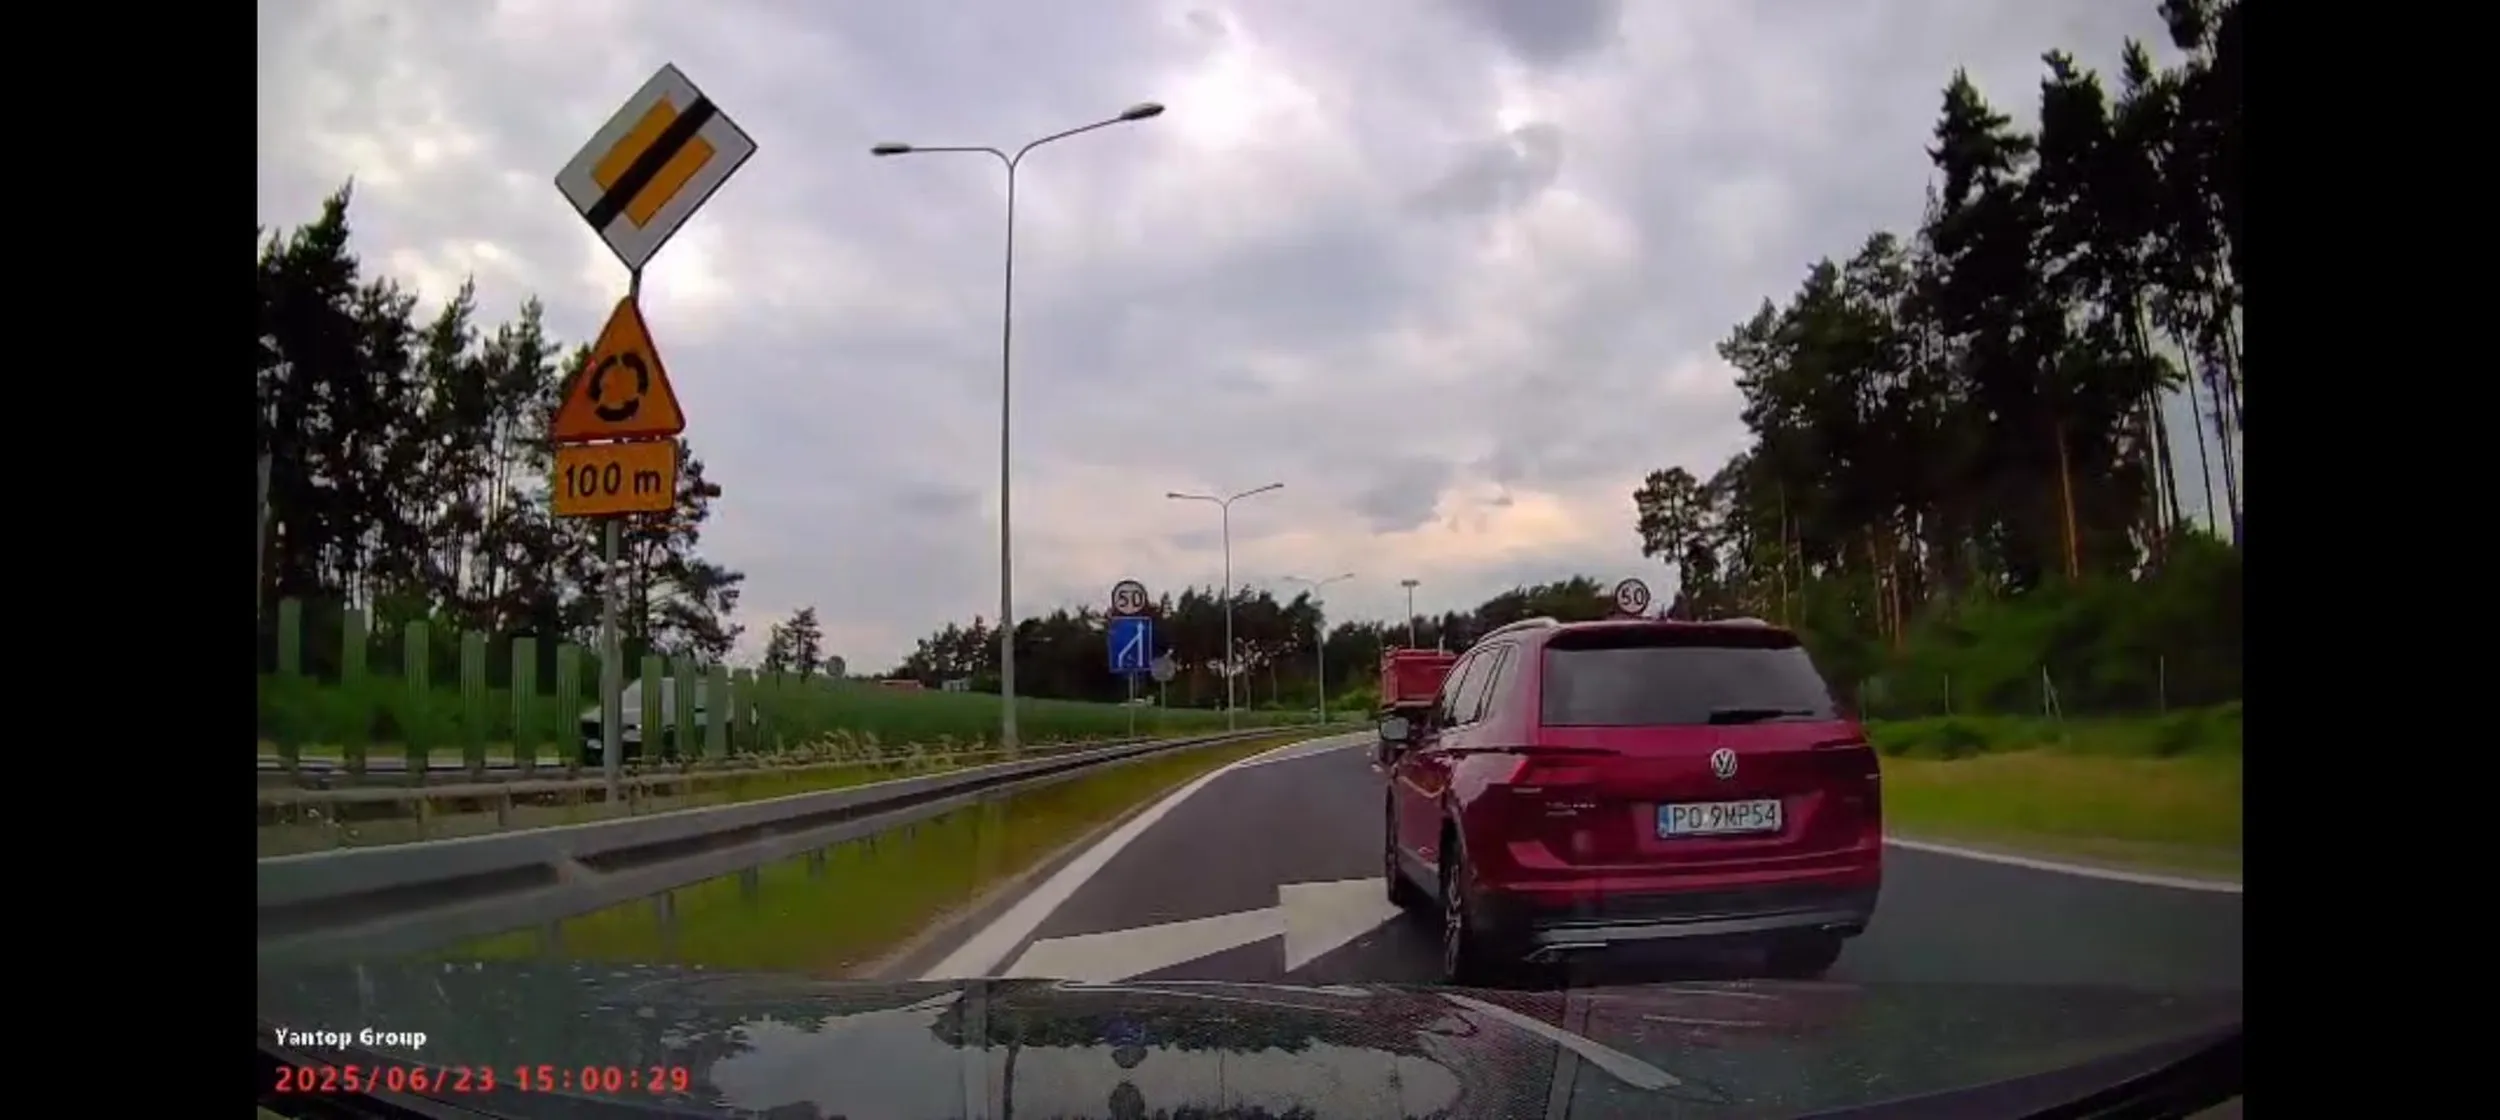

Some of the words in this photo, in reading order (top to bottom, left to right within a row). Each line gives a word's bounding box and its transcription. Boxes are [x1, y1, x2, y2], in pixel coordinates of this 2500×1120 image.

[566, 461, 622, 498] 100
[633, 469, 662, 495] m
[1117, 590, 1143, 608] 50
[1618, 587, 1644, 606] 50
[1672, 805, 1702, 830] PO
[1710, 802, 1777, 827] 9MP54
